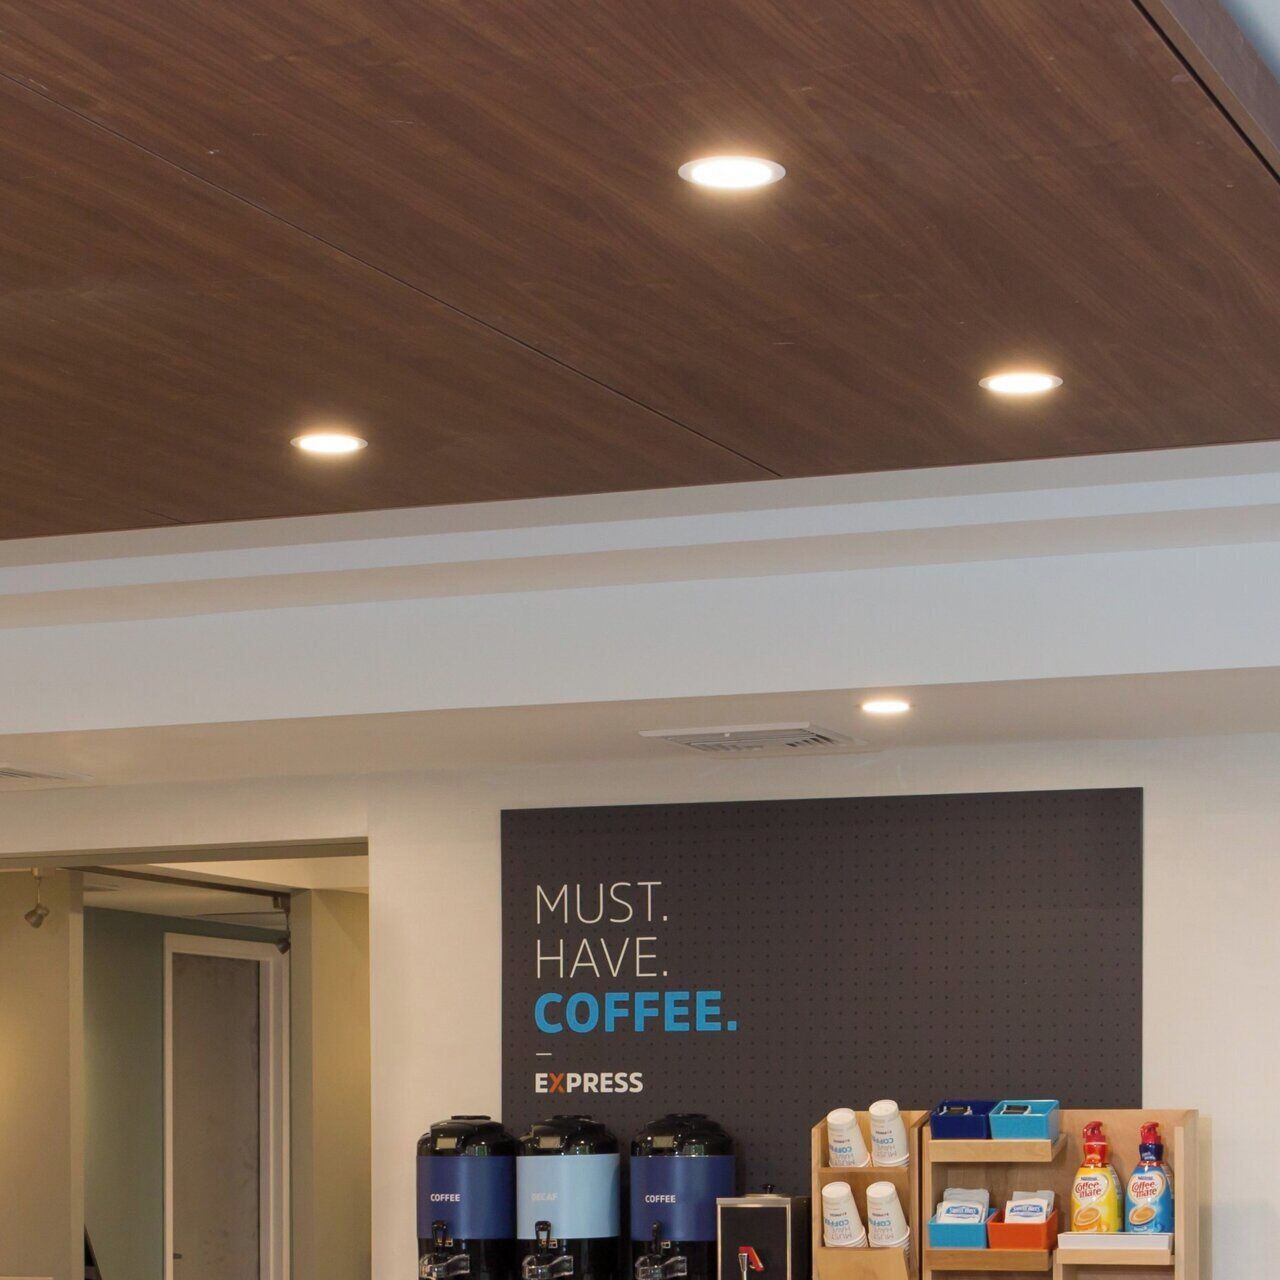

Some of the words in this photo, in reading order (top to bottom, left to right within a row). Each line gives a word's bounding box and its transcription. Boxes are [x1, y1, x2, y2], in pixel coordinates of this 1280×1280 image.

[536, 881, 668, 924] MUST.
[536, 936, 668, 979] HAVE.
[534, 990, 737, 1034] COFFEE.
[535, 1072, 644, 1093] EXPRESS
[430, 1193, 461, 1202] COFFEE
[644, 1194, 676, 1204] COFFEE
